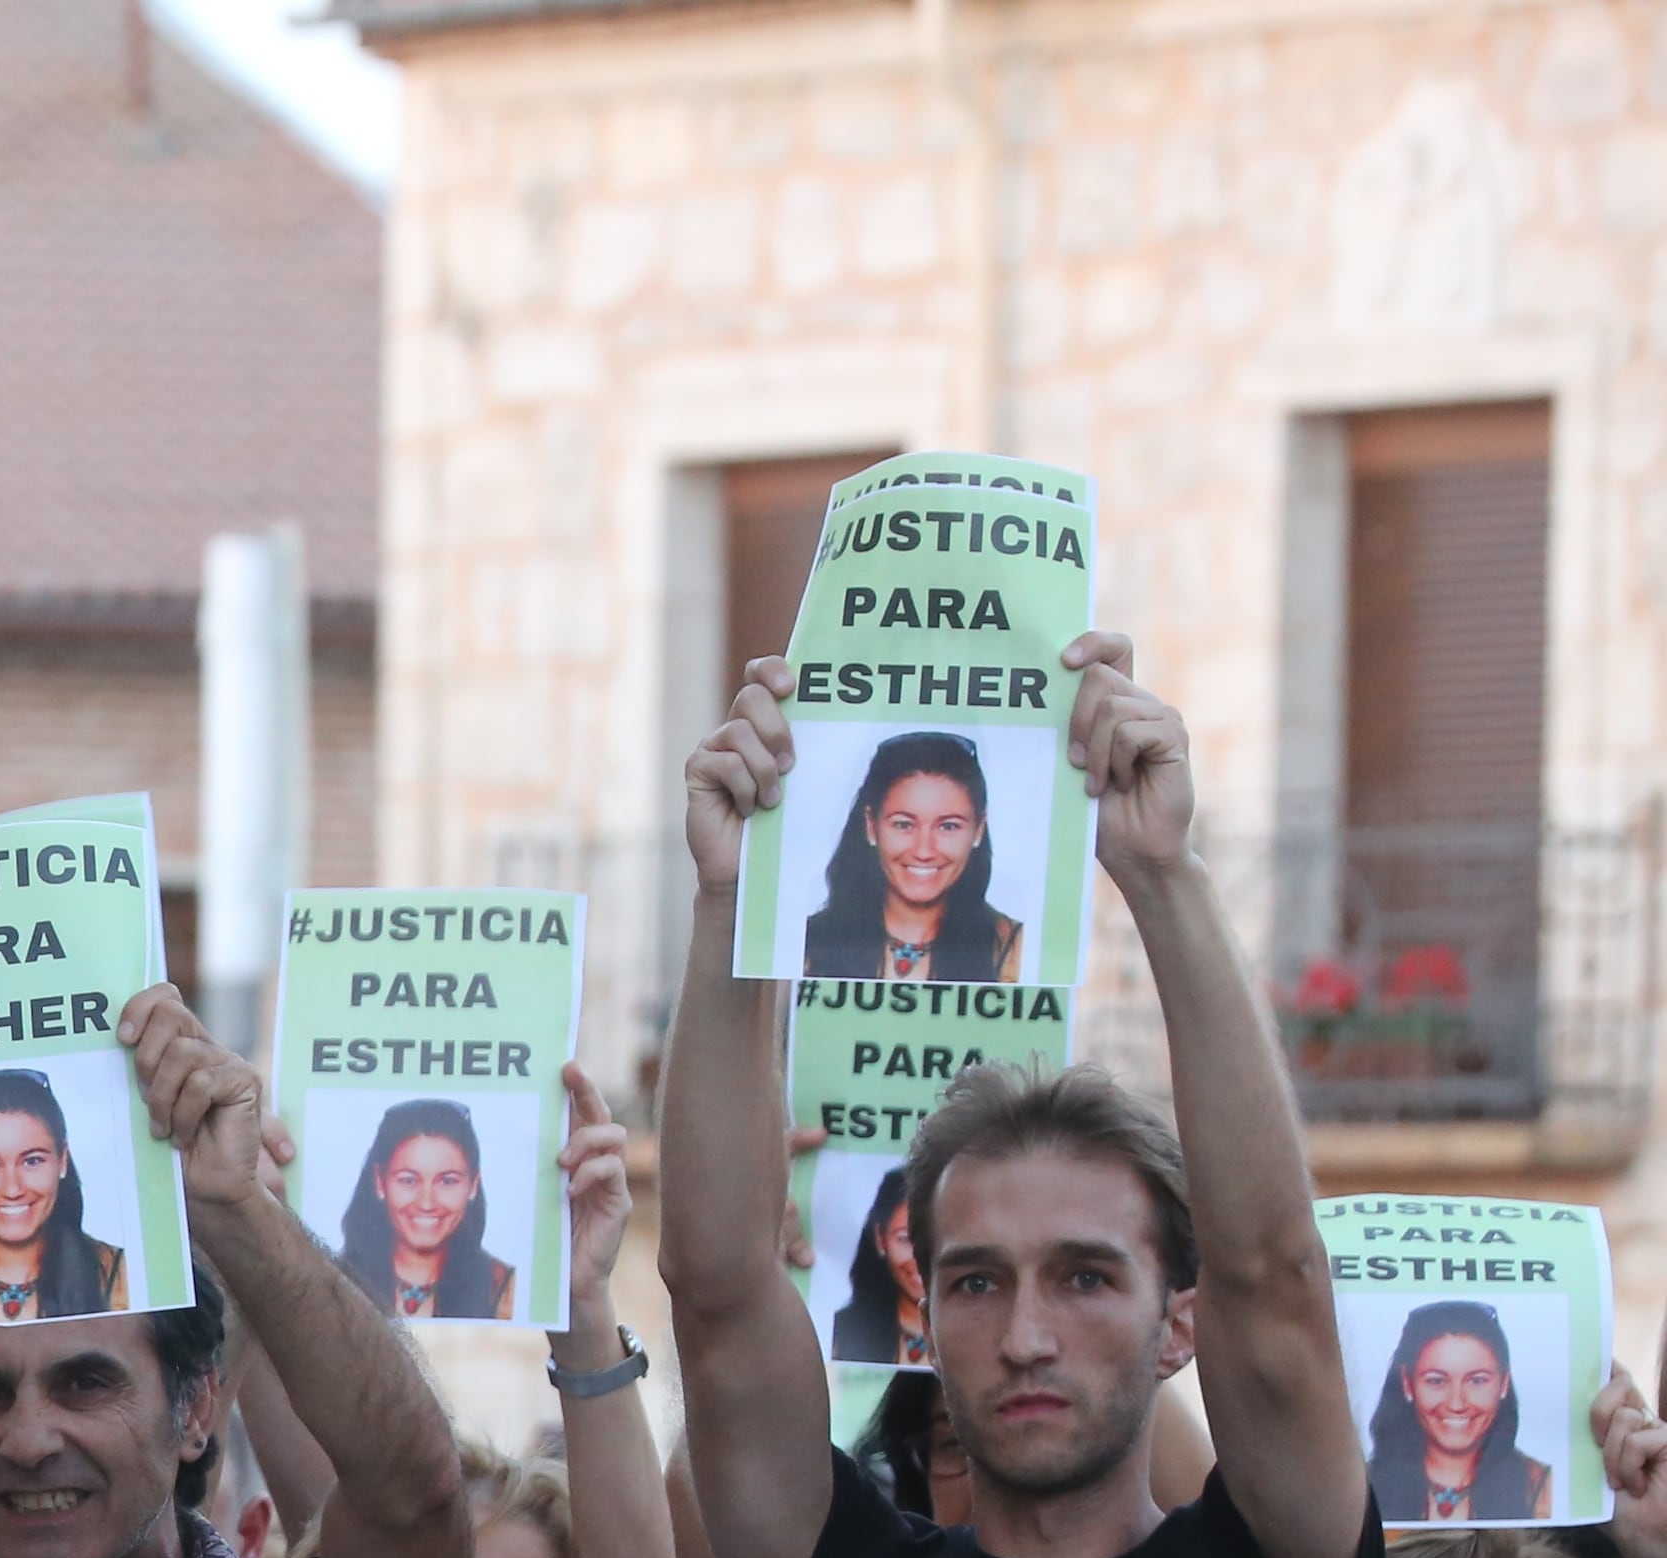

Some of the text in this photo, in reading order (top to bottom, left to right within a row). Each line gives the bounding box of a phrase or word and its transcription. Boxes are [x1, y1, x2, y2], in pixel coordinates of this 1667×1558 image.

[814, 510, 1085, 572] #JUSTICIA
[842, 586, 1011, 630] PARA
[797, 662, 1048, 709] ESTHER
[289, 906, 569, 946] #JUSTICIA
[350, 972, 498, 1008] PARA
[797, 979, 1063, 1021] #JUSTICIA
[311, 1037, 532, 1076] ESTHER
[821, 1102, 924, 1140] EST
[1319, 1201, 1585, 1223] JUSTICIA
[1363, 1226, 1517, 1244] PARA
[1330, 1254, 1557, 1282] ESTHER
